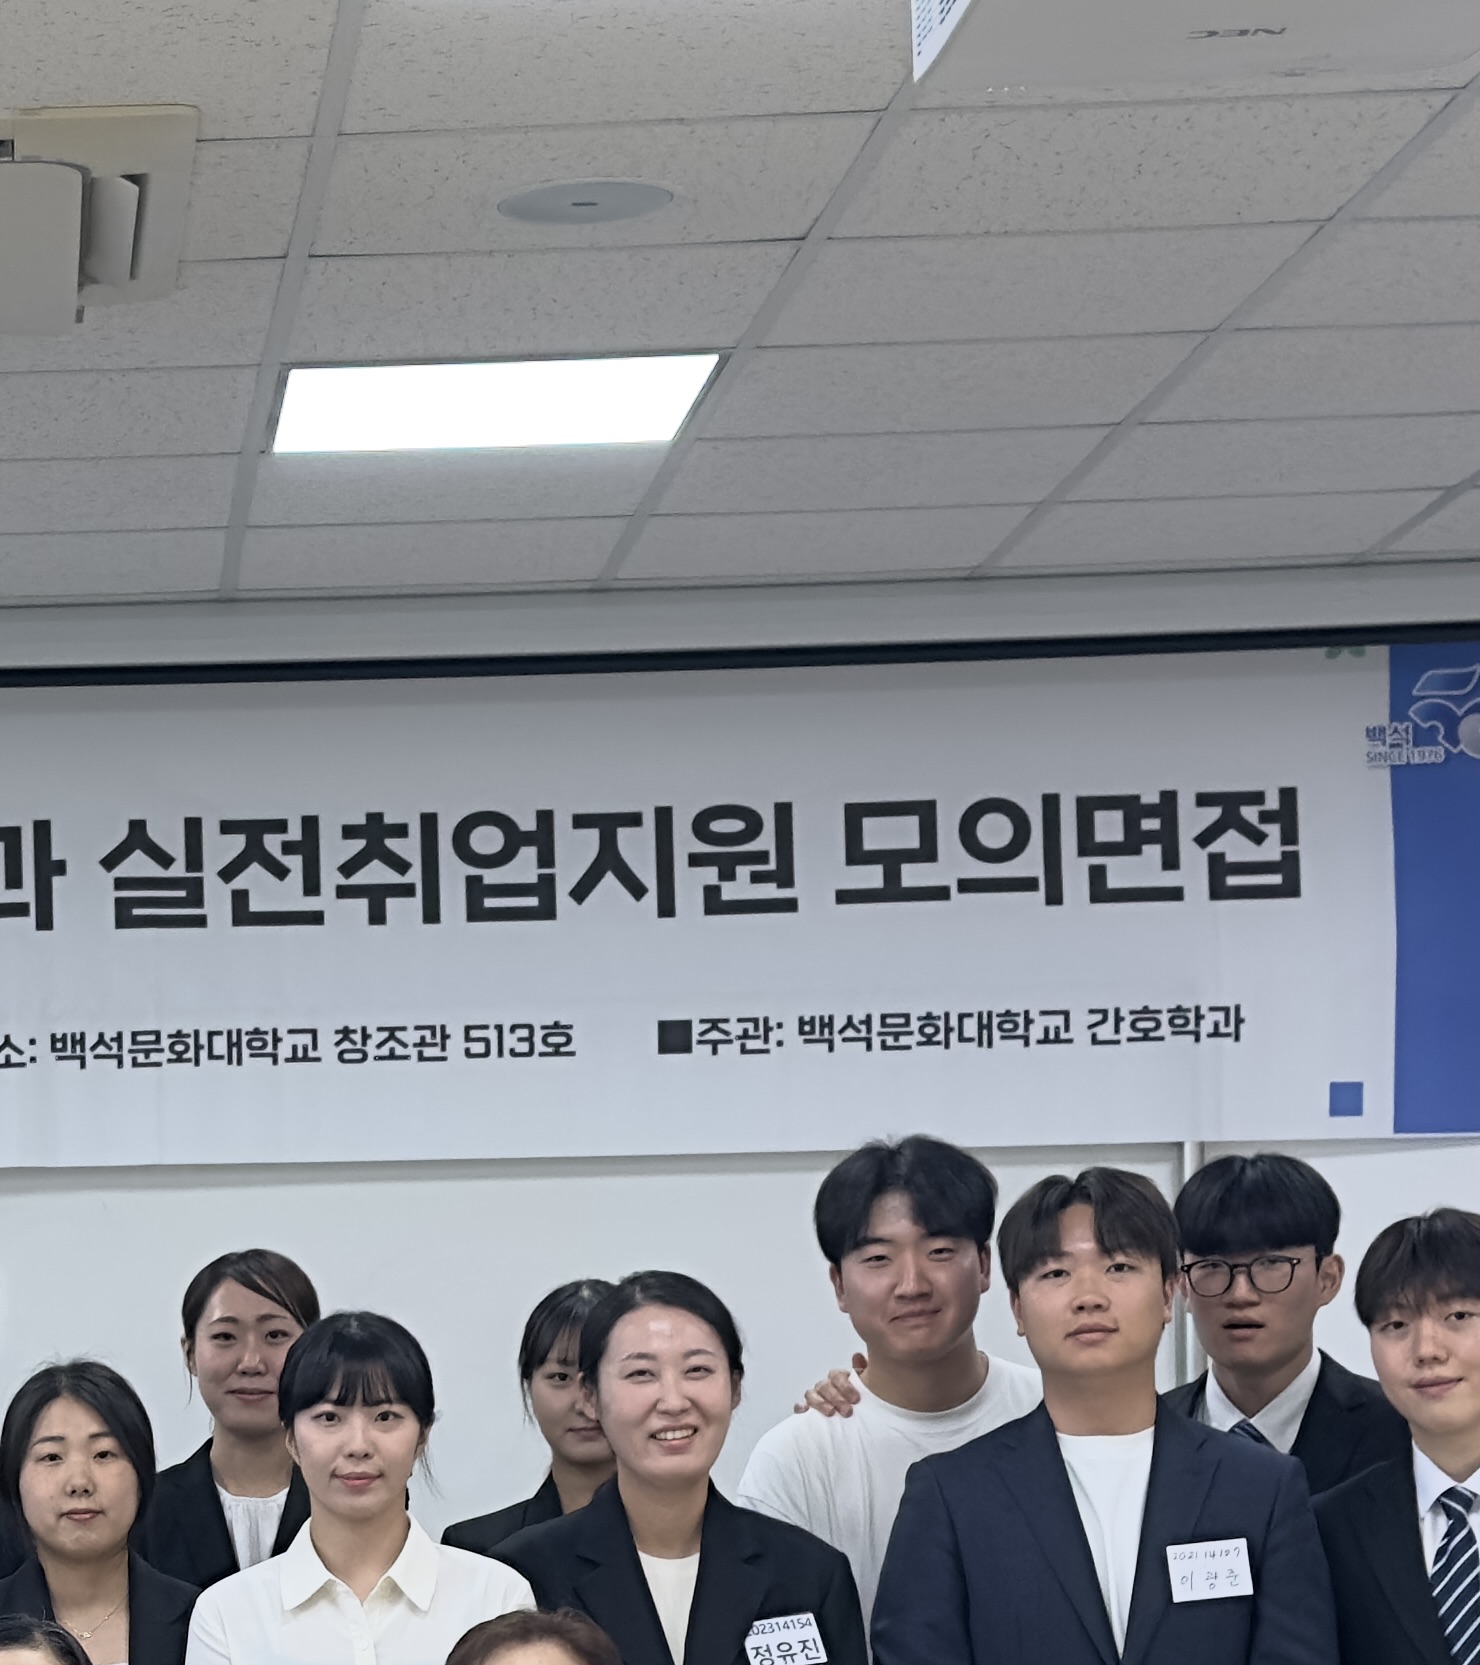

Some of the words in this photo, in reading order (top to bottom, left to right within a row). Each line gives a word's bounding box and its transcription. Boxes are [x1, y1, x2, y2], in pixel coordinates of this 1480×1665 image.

[97, 801, 799, 931] 실전취업지원
[834, 786, 1302, 906] 모의면접
[49, 1026, 323, 1071] 백석문화대학교
[333, 1023, 452, 1065] 창조관
[462, 1020, 577, 1060] 513호
[695, 1014, 786, 1056] 주관:
[797, 1008, 1075, 1053] 백석문화대학교
[1086, 1003, 1246, 1046] 간호학과
